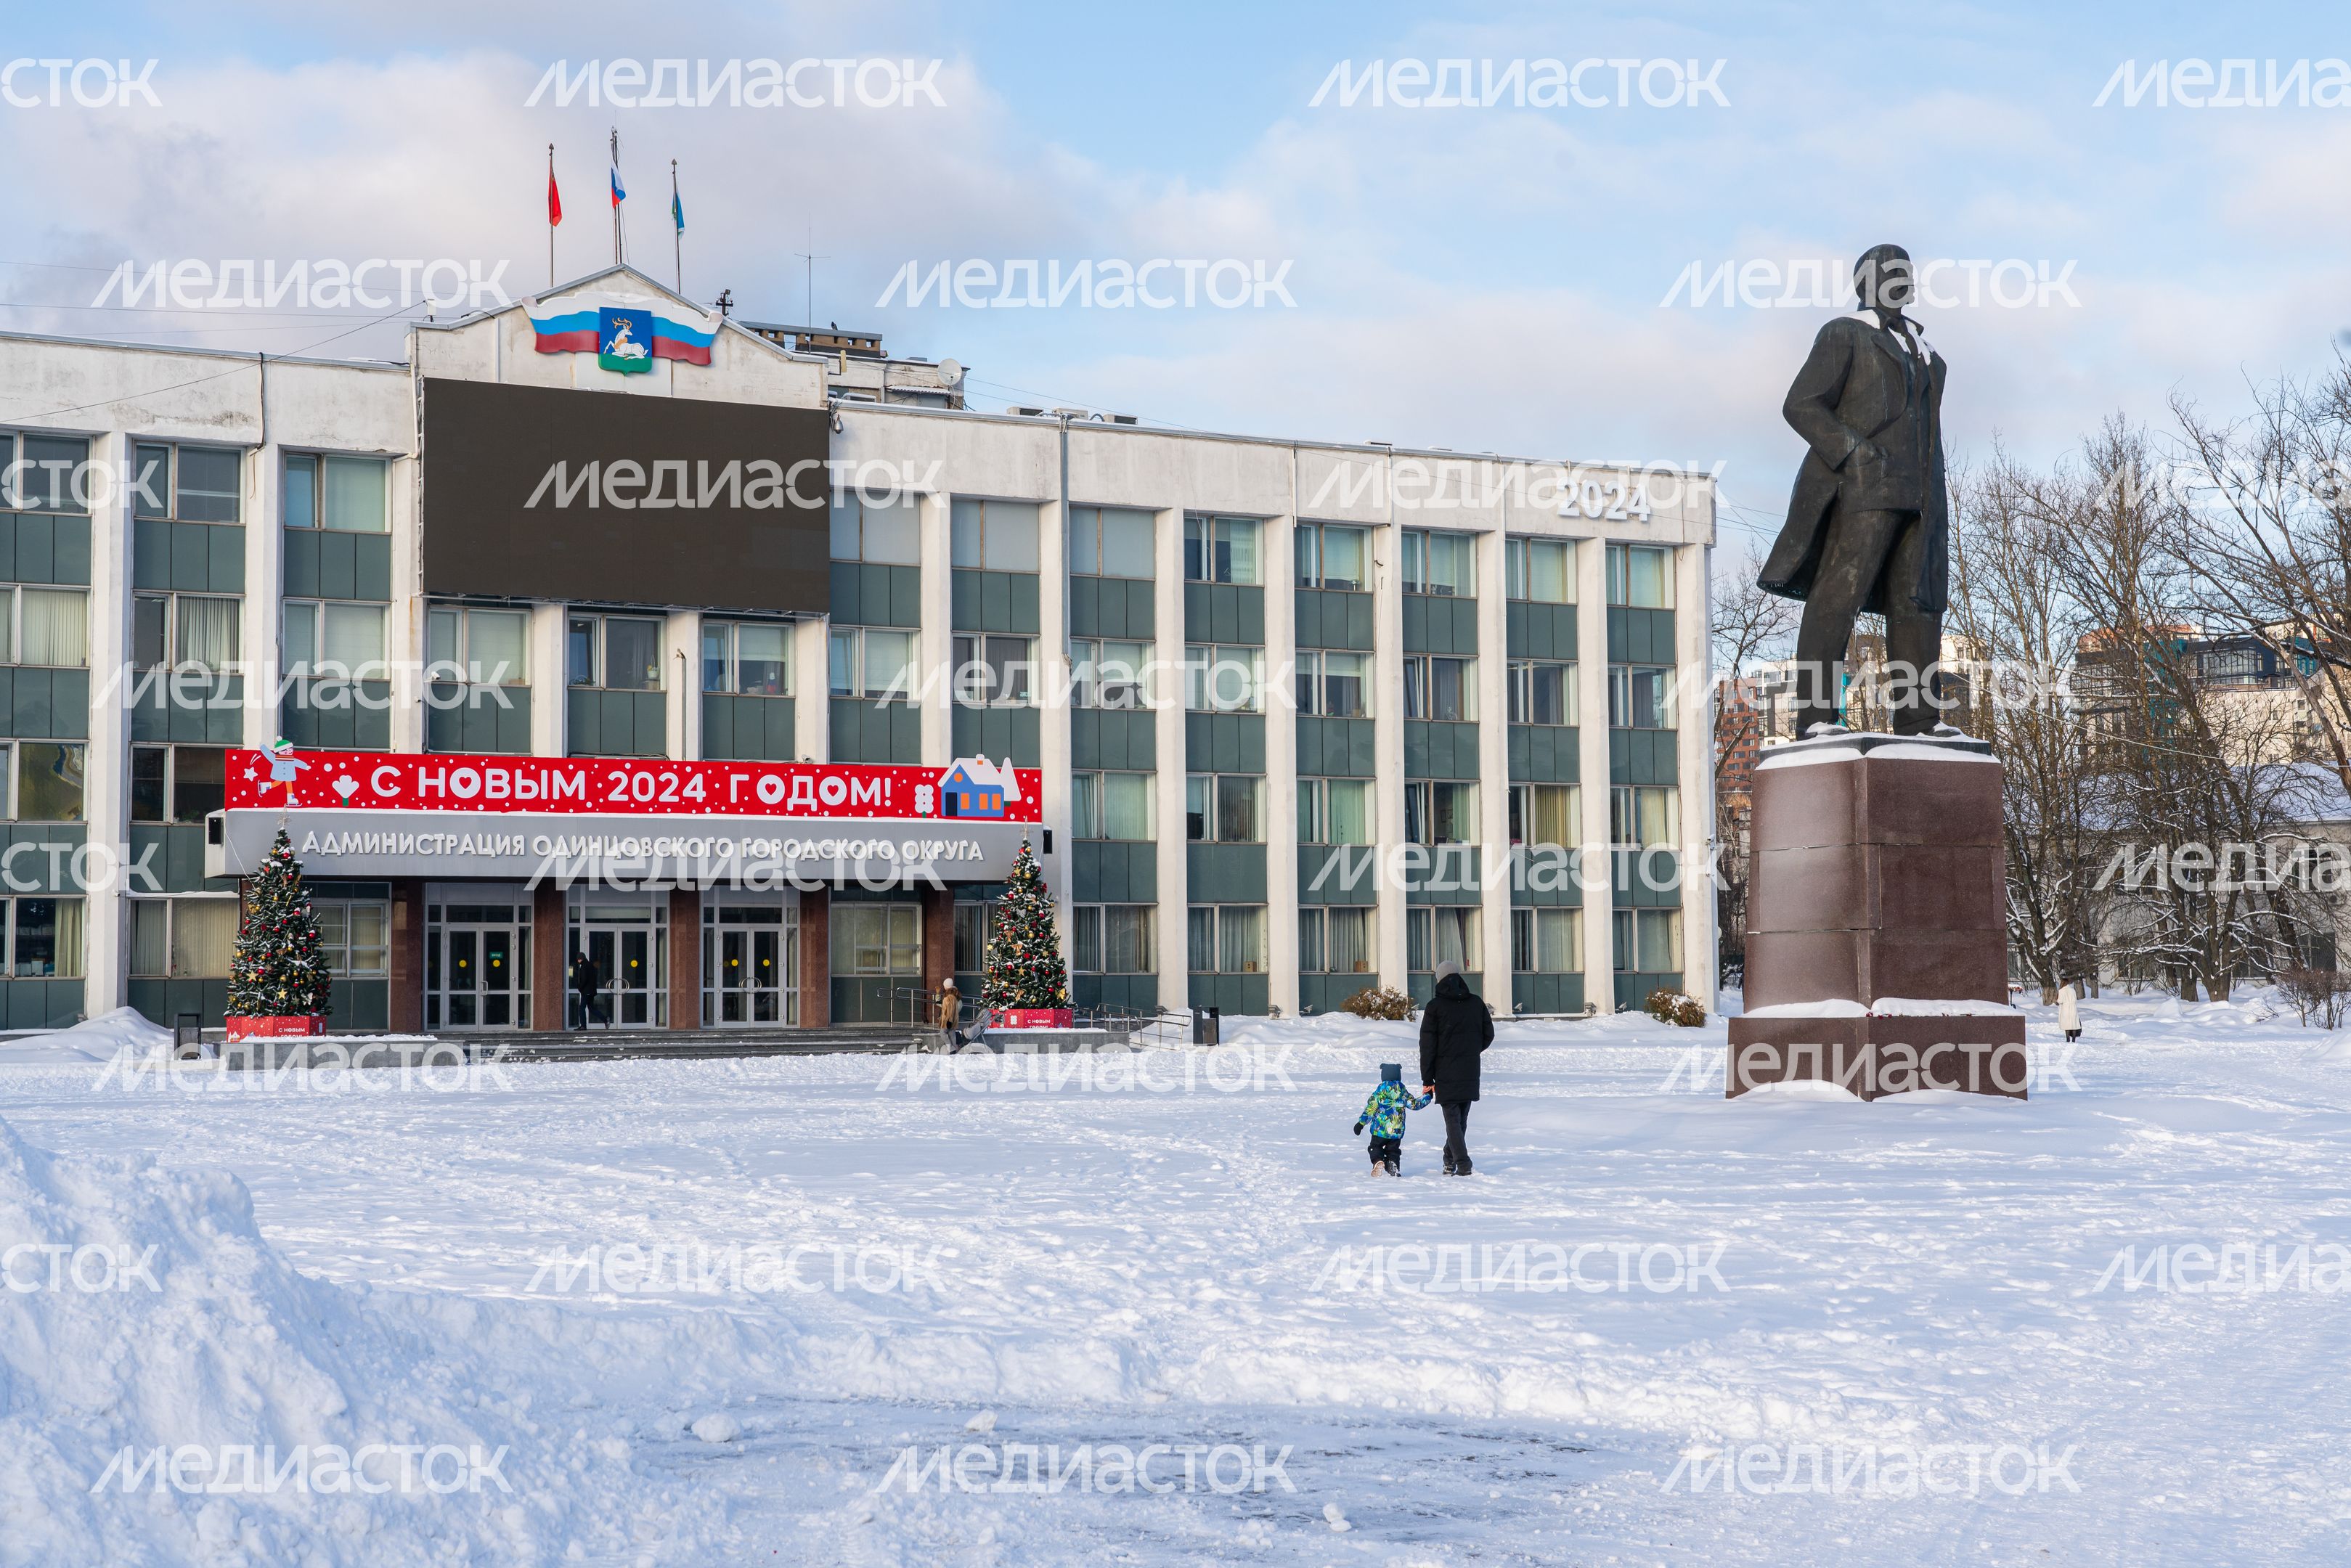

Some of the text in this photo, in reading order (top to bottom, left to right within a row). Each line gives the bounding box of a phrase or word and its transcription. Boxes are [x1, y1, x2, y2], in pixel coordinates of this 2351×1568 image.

[1556, 477, 1651, 521] 2024
[370, 765, 892, 812] С НОВЫМ 2024 ГОДОМ!
[302, 831, 984, 862] АДМИНИСТРАЦИЯ ОДИНЦОВСКОГО ГОРОДСКОГО ОКРУГА
